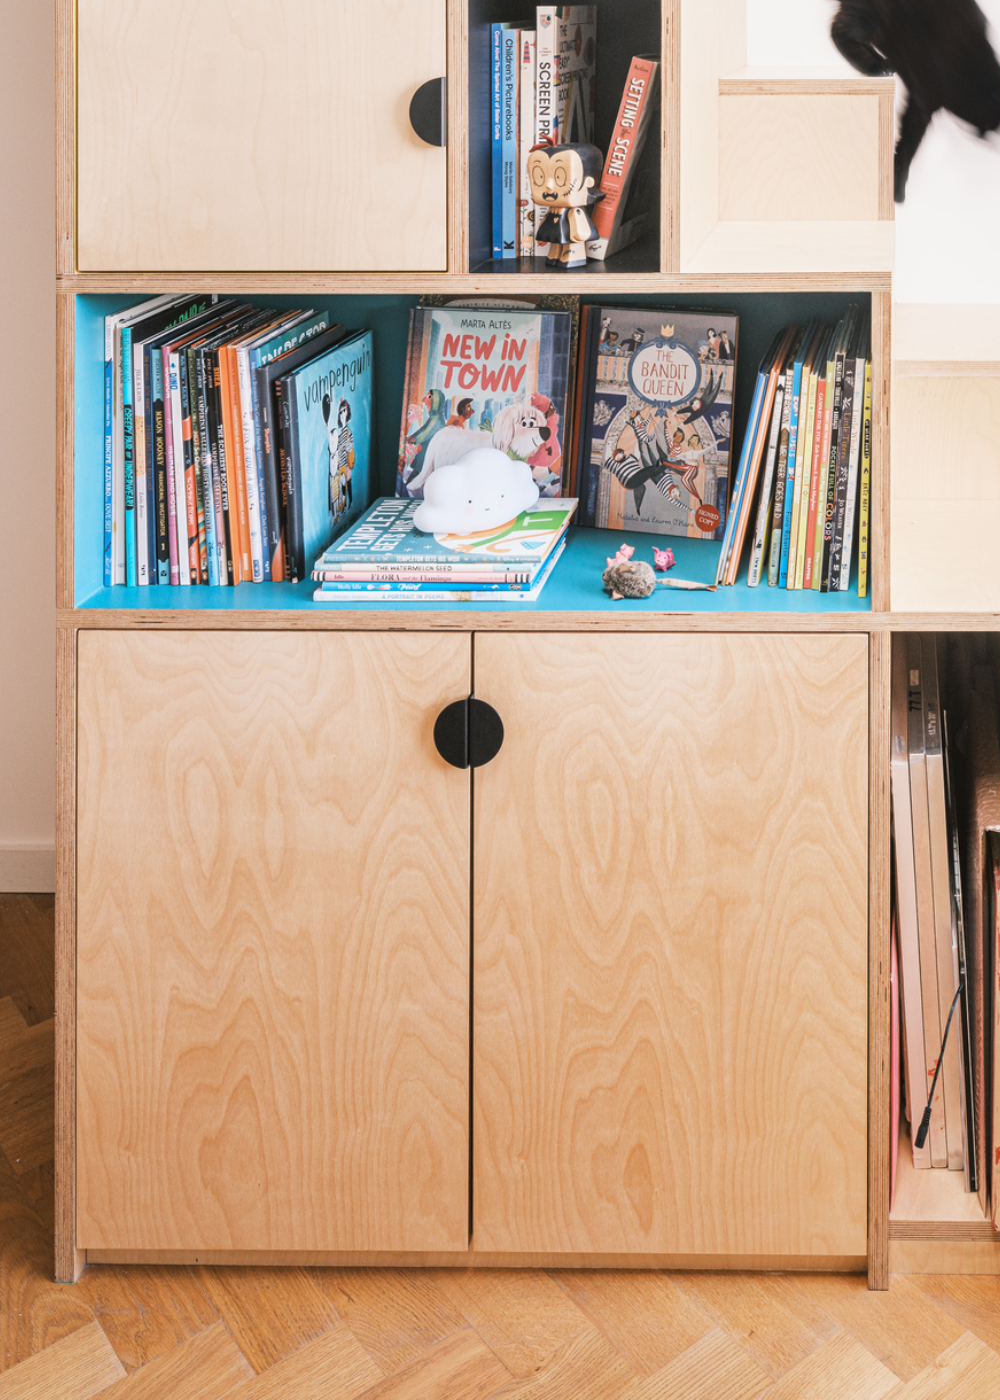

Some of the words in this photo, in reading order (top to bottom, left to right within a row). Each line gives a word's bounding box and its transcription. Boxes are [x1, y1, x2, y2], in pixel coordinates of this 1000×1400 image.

[505, 38, 514, 81] Children's
[539, 62, 551, 116] SCREEN
[505, 83, 514, 140] Picturebooks
[622, 77, 645, 128] SETTING
[539, 120, 550, 144] PRI
[608, 137, 630, 177] SCENE
[461, 319, 486, 329] MARTA
[488, 318, 512, 329] ALTÉS
[442, 333, 496, 360] NEW
[656, 350, 675, 363] THE
[170, 372, 178, 389] DINO
[304, 343, 370, 412] vampenguin
[440, 360, 526, 392] TOWN
[641, 361, 689, 380] BANDIT
[642, 379, 684, 396] QUEEN
[124, 407, 132, 433] CREEPY
[843, 412, 851, 432] Little
[125, 435, 133, 449] PAIR
[780, 445, 787, 457] MR
[789, 425, 797, 457] SWAPSIES
[841, 434, 850, 459] Tigers
[850, 432, 858, 454] Whale
[777, 460, 786, 477] TIGER
[125, 460, 134, 507] UNDERWEAR!
[775, 482, 784, 500] GOES
[698, 509, 719, 520] SIGNED
[699, 517, 715, 527] COPY
[774, 503, 782, 519] WILD
[824, 502, 834, 541] COLORS
[336, 499, 410, 551] TEMPLETON
[370, 534, 406, 551] GETS
